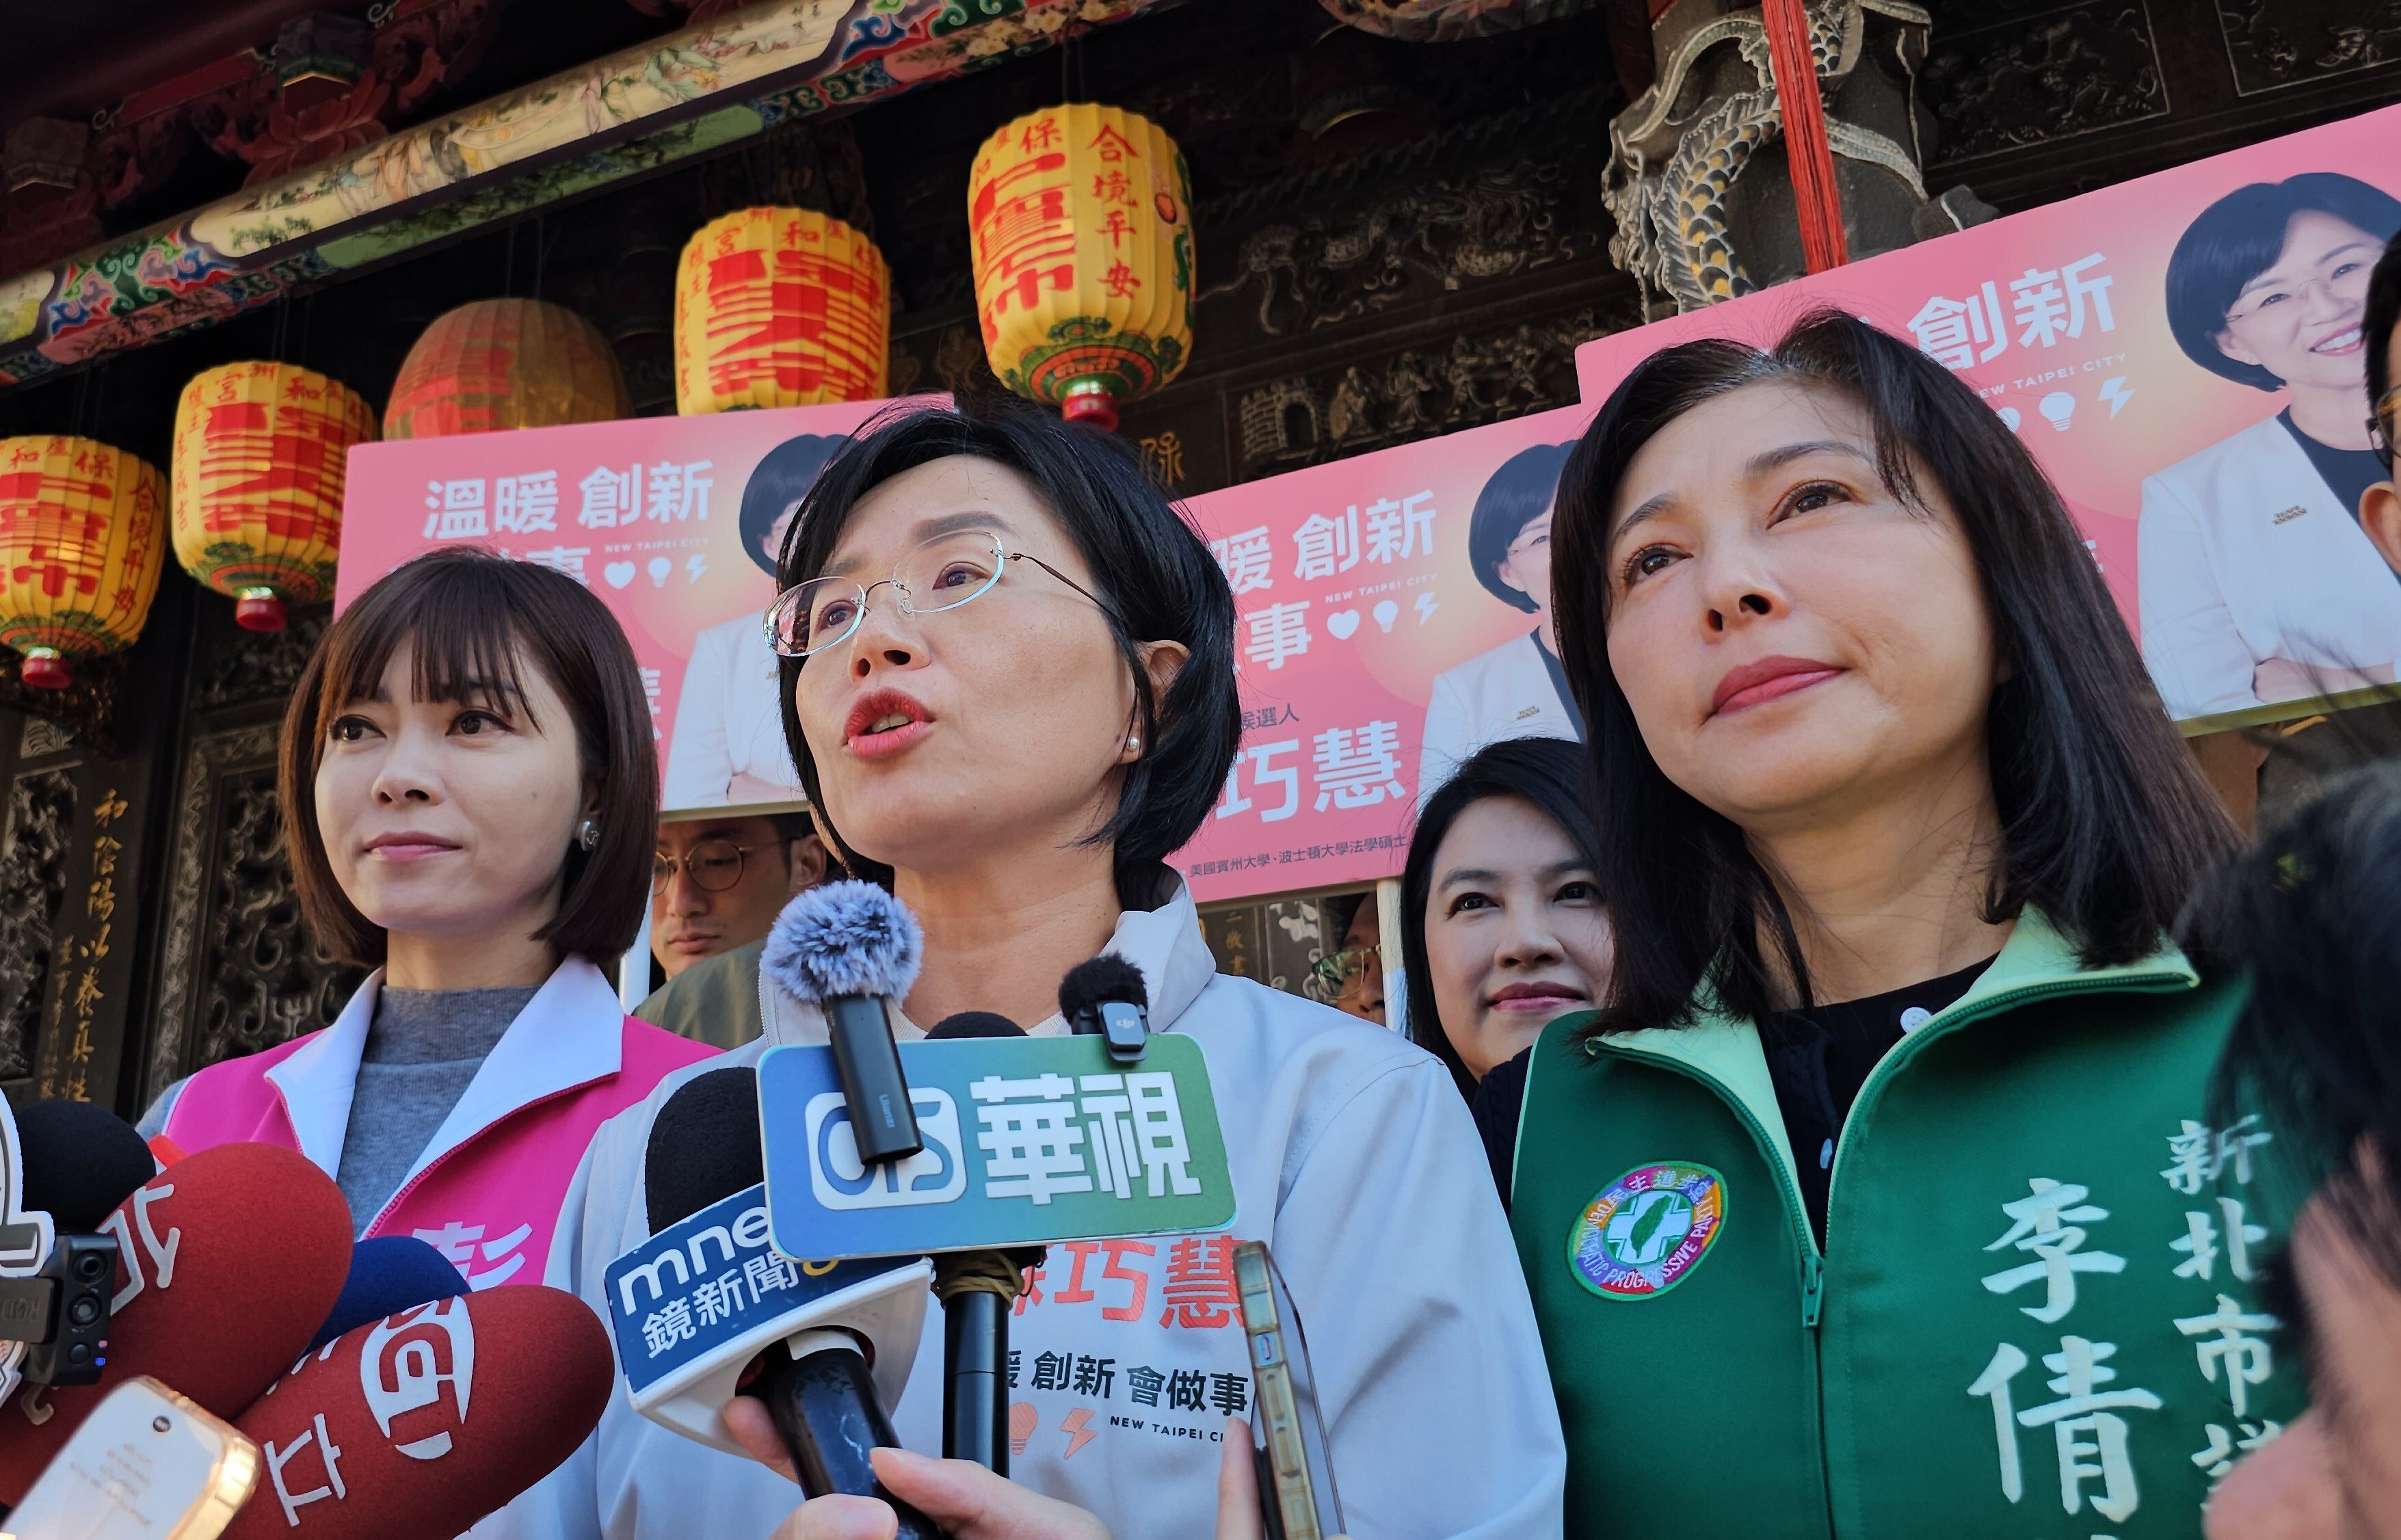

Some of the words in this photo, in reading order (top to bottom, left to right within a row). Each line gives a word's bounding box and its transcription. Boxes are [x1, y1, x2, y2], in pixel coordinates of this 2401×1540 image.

[1086, 124, 1141, 300] 合境平安
[1907, 252, 2116, 371] 創新
[1979, 384, 2006, 399] EW
[2013, 367, 2076, 390] TAIPEI
[2068, 352, 2127, 373] CITY
[111, 478, 161, 614] 合境平安
[422, 469, 559, 540] 溫暖
[576, 459, 715, 530] 創新
[605, 544, 633, 554] NEW
[637, 539, 677, 552] TAIPEI
[681, 537, 711, 548] CITY
[1208, 525, 1275, 596] 暖
[1292, 488, 1437, 582] 創新
[1242, 600, 1313, 672] 事
[1325, 589, 1354, 605] NEW
[1358, 581, 1402, 598] TAIPEI
[1406, 572, 1439, 588] CITY
[1215, 719, 1406, 823] 巧慧
[818, 1100, 955, 1196] CS
[970, 1071, 1202, 1206] 華視
[1602, 1240, 1699, 1289] PROGRESSIVE
[1690, 1195, 1714, 1238] PARTY
[641, 1249, 799, 1359] 鏡新聞
[1031, 1350, 1116, 1399] 創新
[1126, 1365, 1249, 1417] 會做事
[1967, 1177, 2163, 1539] 李倩
[264, 1361, 347, 1528] 立
[1110, 1416, 1145, 1431] NEW
[1152, 1423, 1203, 1440] TAIPEI
[1209, 1431, 1224, 1443] CI
